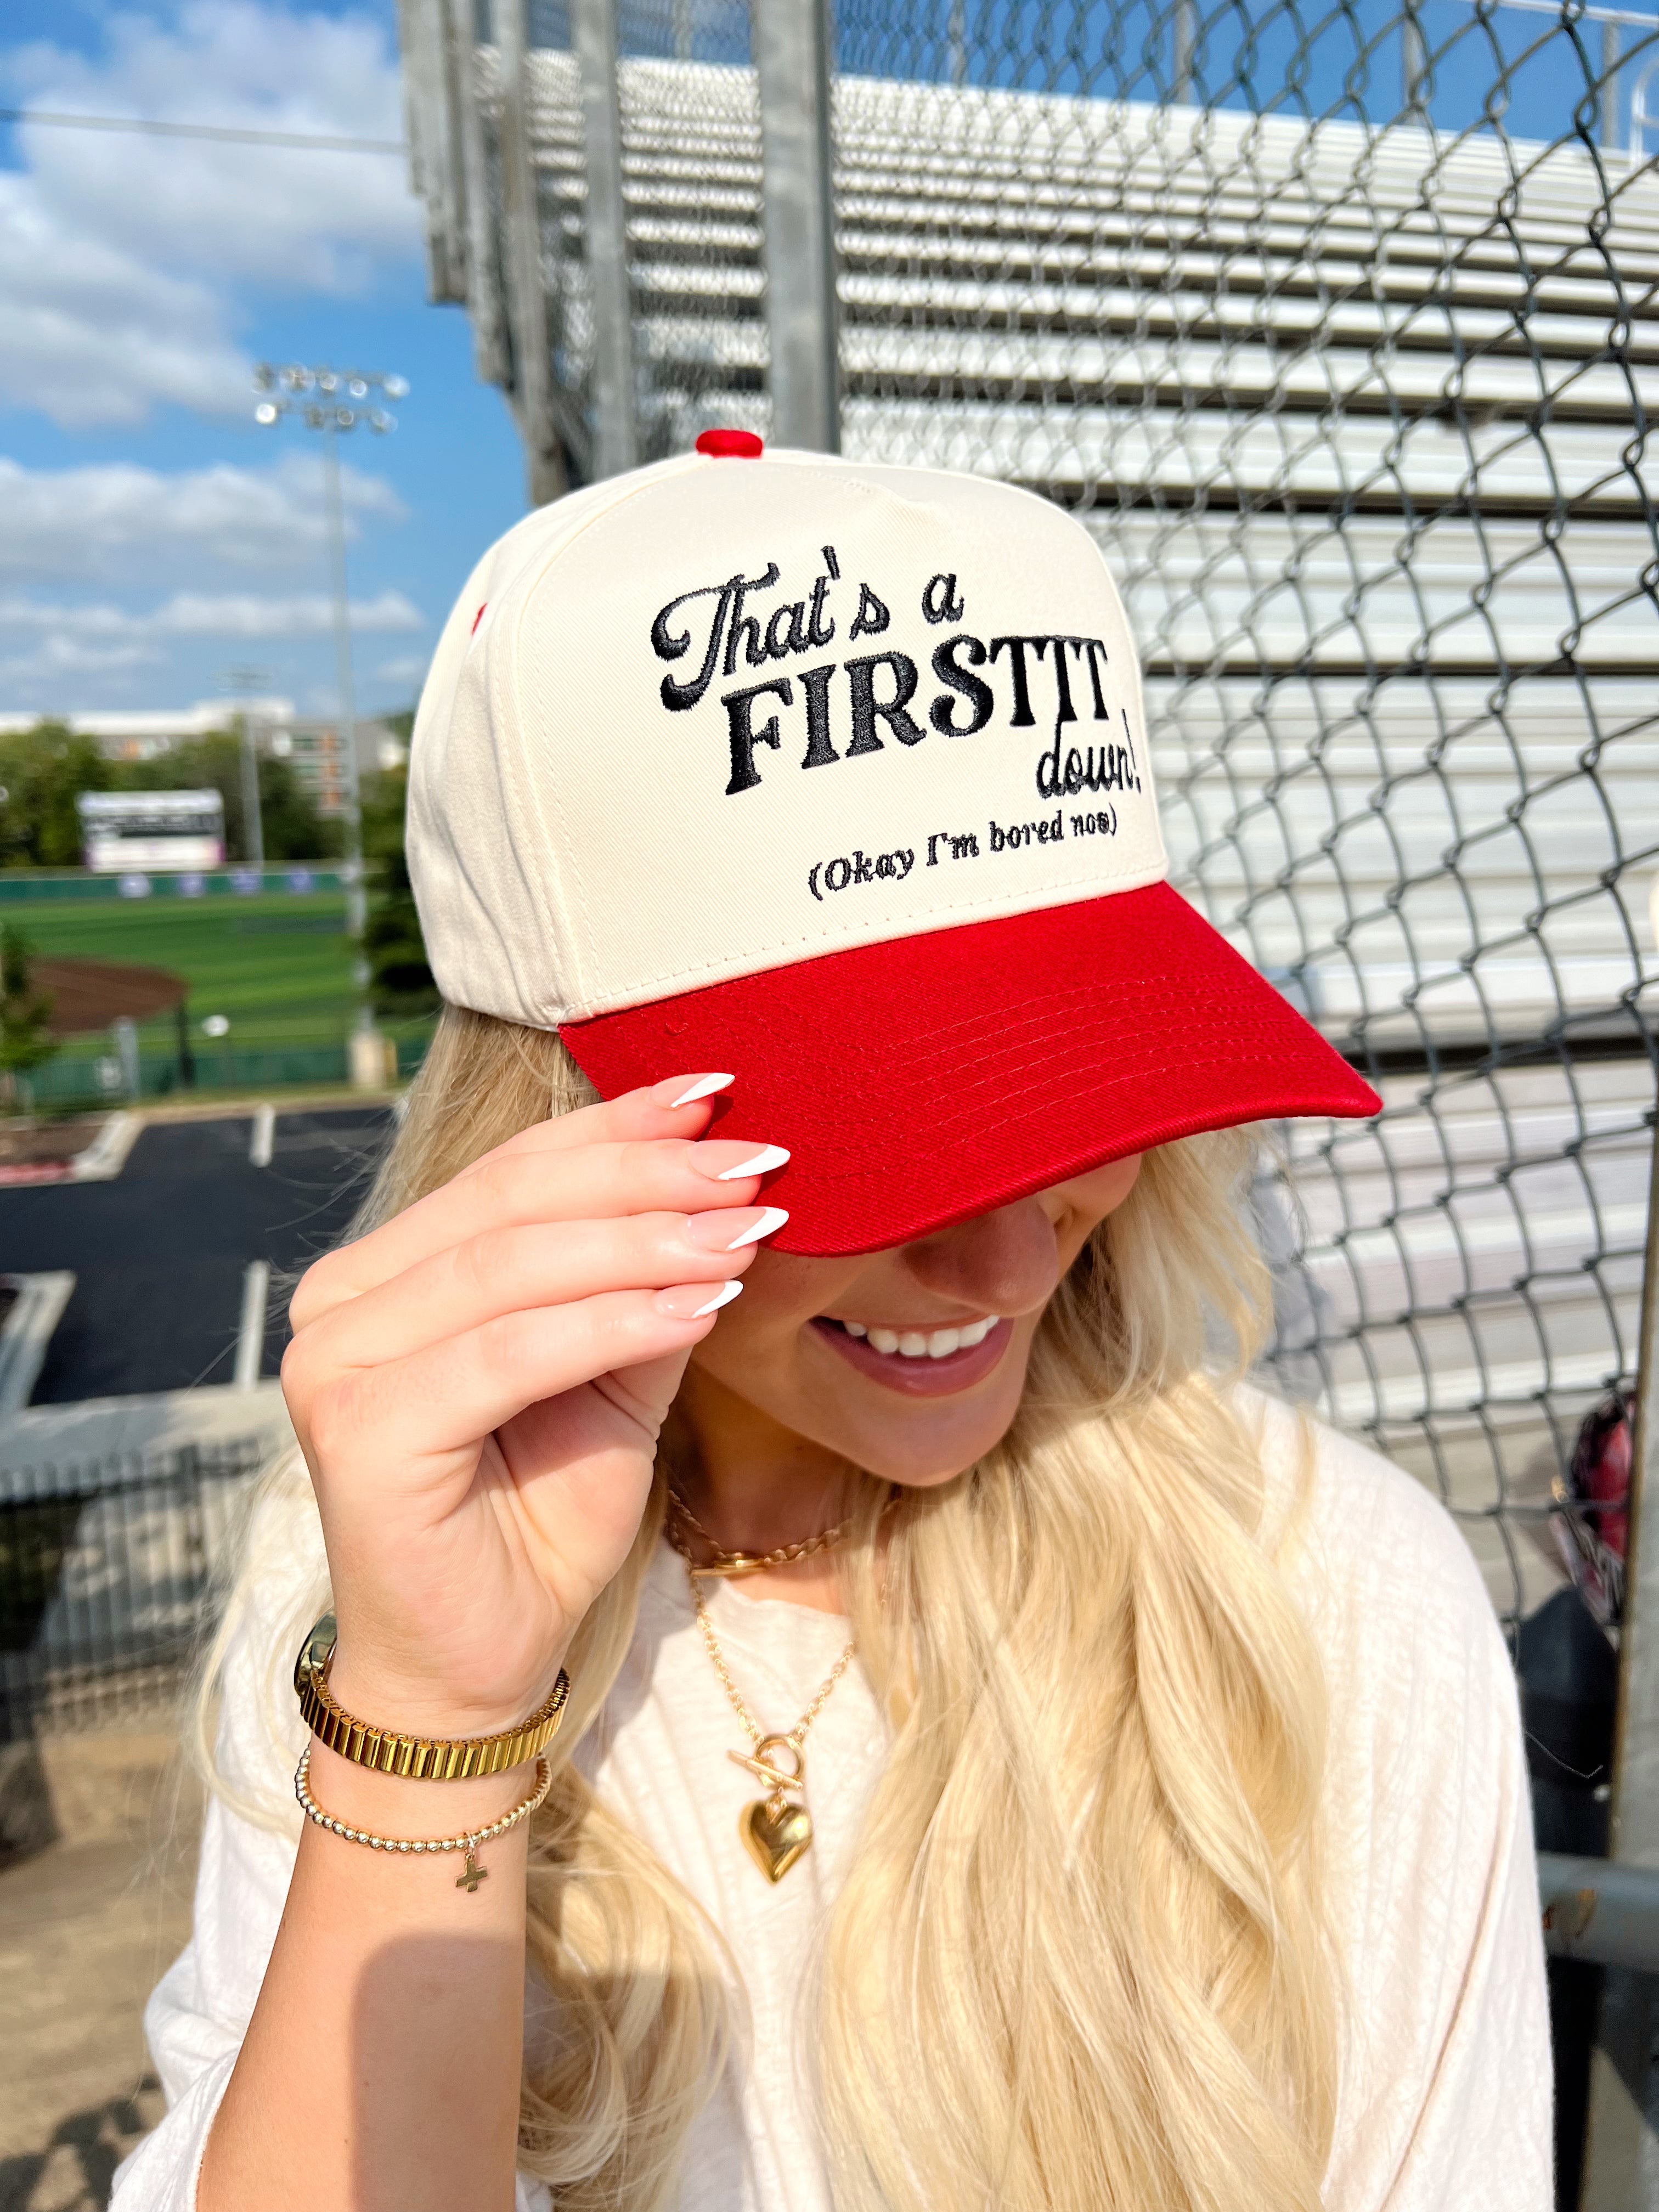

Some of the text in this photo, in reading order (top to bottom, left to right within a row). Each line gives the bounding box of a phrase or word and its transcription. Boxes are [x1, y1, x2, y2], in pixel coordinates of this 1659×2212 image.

[650, 545, 964, 712] That's a
[720, 633, 1109, 795] FIRSTTT
[1035, 709, 1142, 800] down!
[808, 849, 915, 901] (Okay
[926, 832, 980, 867] I'm
[988, 809, 1064, 853] bored
